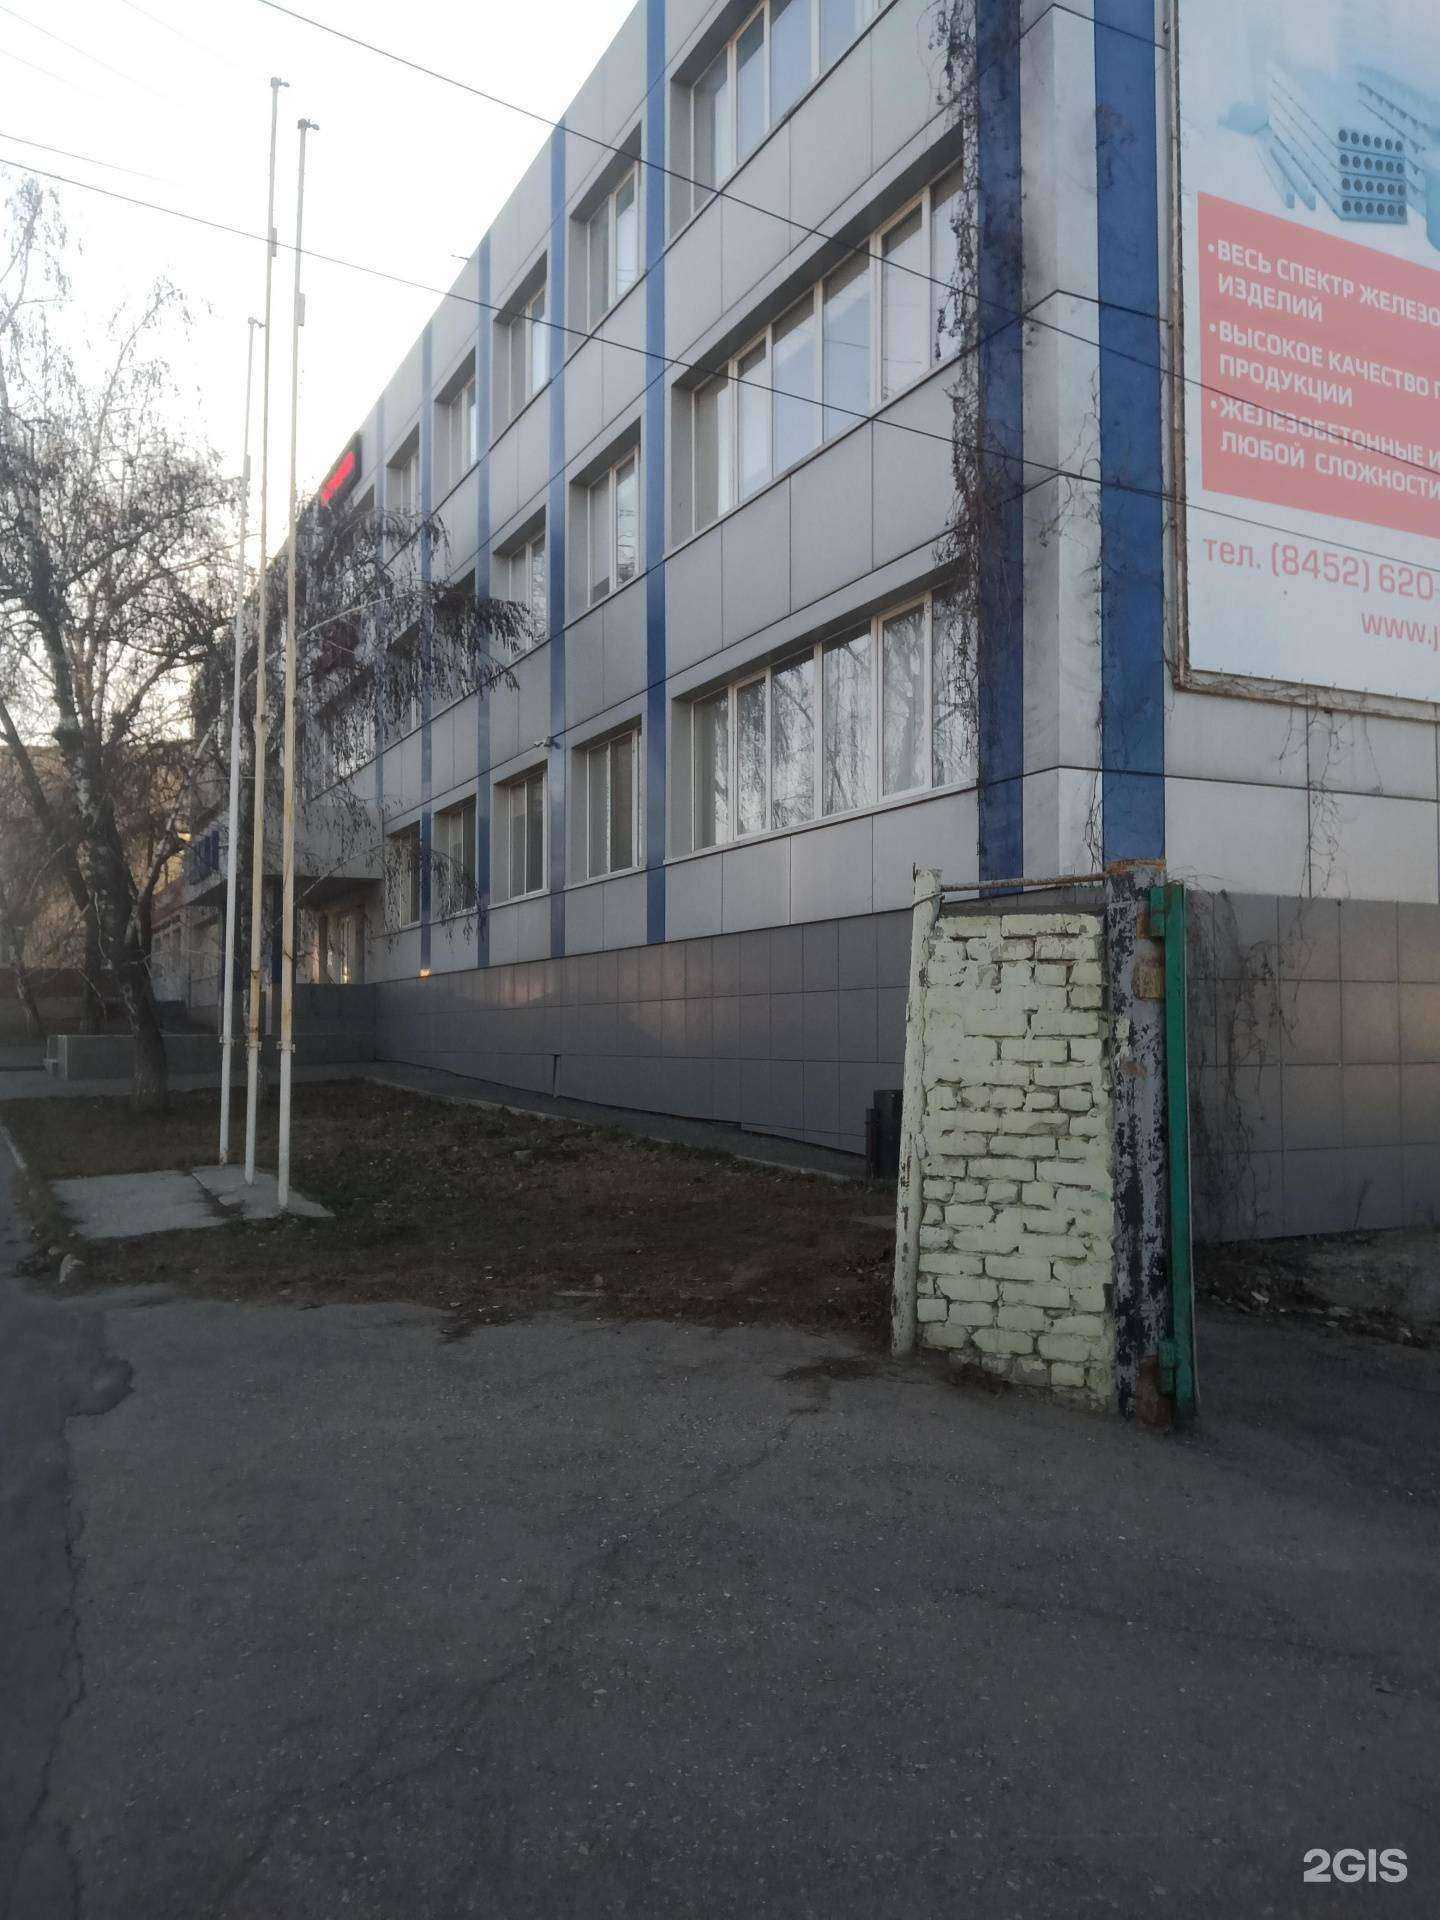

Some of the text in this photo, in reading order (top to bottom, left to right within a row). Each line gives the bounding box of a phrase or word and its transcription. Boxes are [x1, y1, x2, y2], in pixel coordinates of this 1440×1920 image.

[1217, 239, 1272, 274] ВЕСЬ
[1276, 257, 1355, 299] СПЕКТР
[1218, 272, 1324, 323] ИЗДЕЛИЙ
[1219, 320, 1429, 397] ВЫСОКОЕ КАЧЕСТВО
[1219, 353, 1353, 408] ПРОДУКЦИИ
[1219, 395, 1424, 467] ЖЕЛЕЗОБЕТОННЫЕ
[1220, 430, 1440, 501] ЛЮБОЙ СЛОЖНОСТИ
[1203, 538, 1261, 571] тел.
[1270, 541, 1370, 593] (8452)
